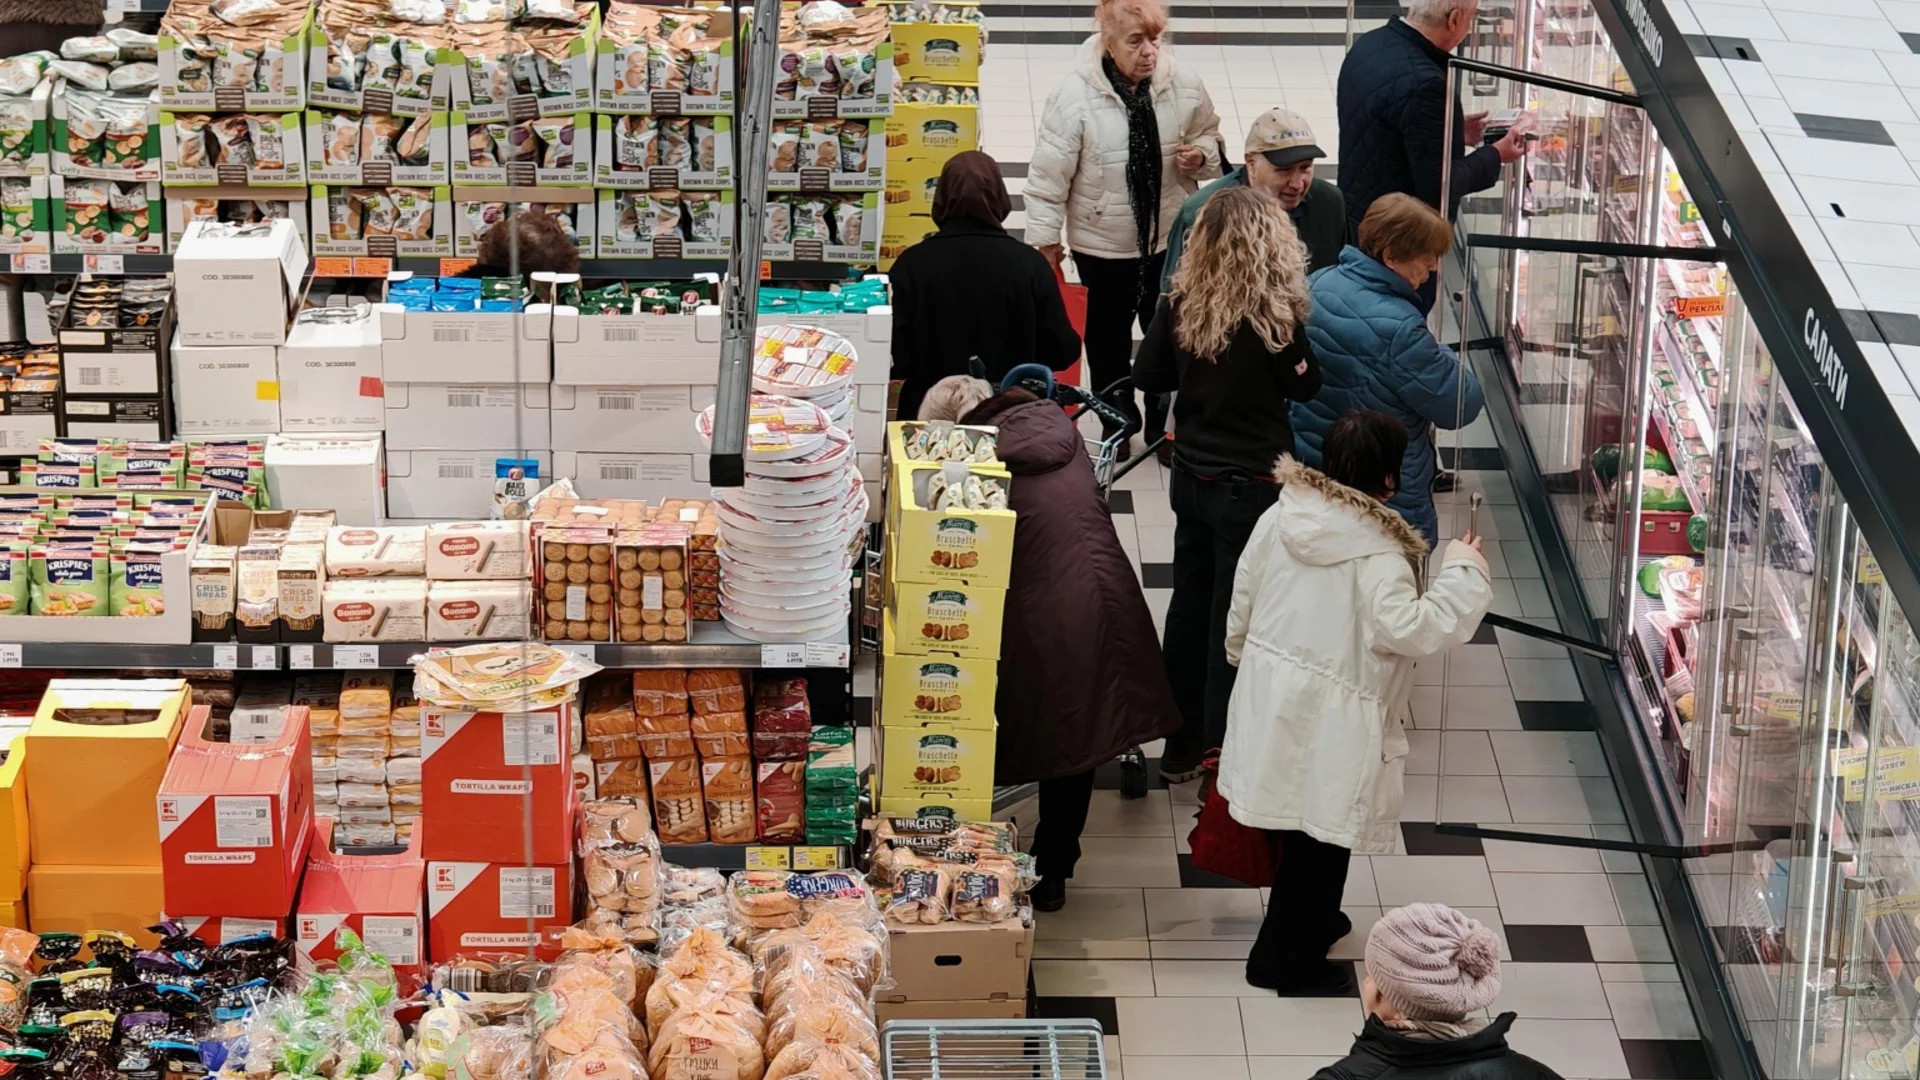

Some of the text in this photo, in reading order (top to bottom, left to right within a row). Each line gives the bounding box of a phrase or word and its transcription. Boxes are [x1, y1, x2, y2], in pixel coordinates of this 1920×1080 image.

[1804, 307, 1848, 410] САЛАТИ
[128, 460, 170, 470] KRISPIES
[37, 475, 78, 486] KRISPIES
[936, 534, 976, 546] Bruschette
[442, 543, 478, 552] Bonomi
[48, 560, 91, 571] KRISPIES
[128, 564, 162, 574] KRISPIE
[196, 584, 227, 592] CRISP
[282, 588, 313, 596] CRISP
[337, 607, 372, 618] Bonomi
[442, 607, 478, 616] Bonomi
[927, 606, 968, 618] Bruschette
[920, 678, 959, 690] Bruschette
[918, 749, 958, 762] Bruschette
[895, 819, 944, 830] BURGERS
[892, 838, 940, 846] BURGERS
